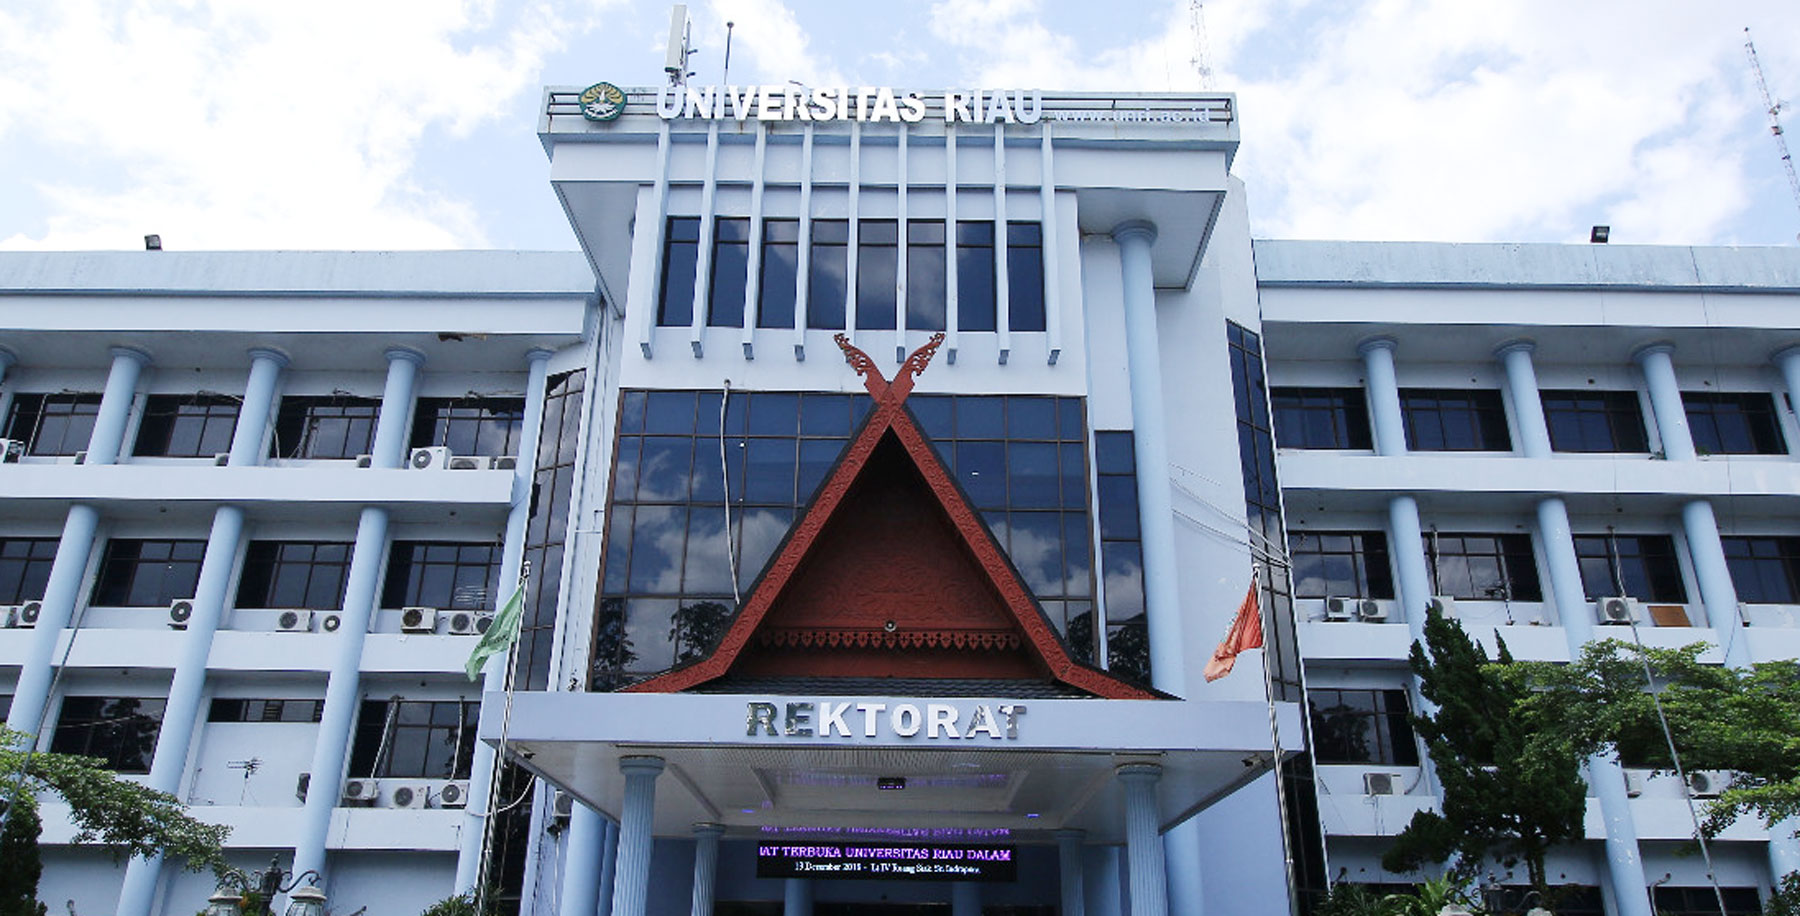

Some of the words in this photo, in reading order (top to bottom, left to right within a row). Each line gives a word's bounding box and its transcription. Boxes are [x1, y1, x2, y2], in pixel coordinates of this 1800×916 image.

[655, 84, 926, 122] UNIVERSITAS
[944, 88, 1042, 124] RIAU
[1054, 107, 1209, 123] www.unri.ac.id
[747, 702, 1027, 739] REKTORAT
[781, 846, 842, 858] TERBUKA
[844, 847, 929, 860] UNIVERSITAS
[932, 849, 964, 860] RIAU
[966, 850, 1012, 862] DALAM
